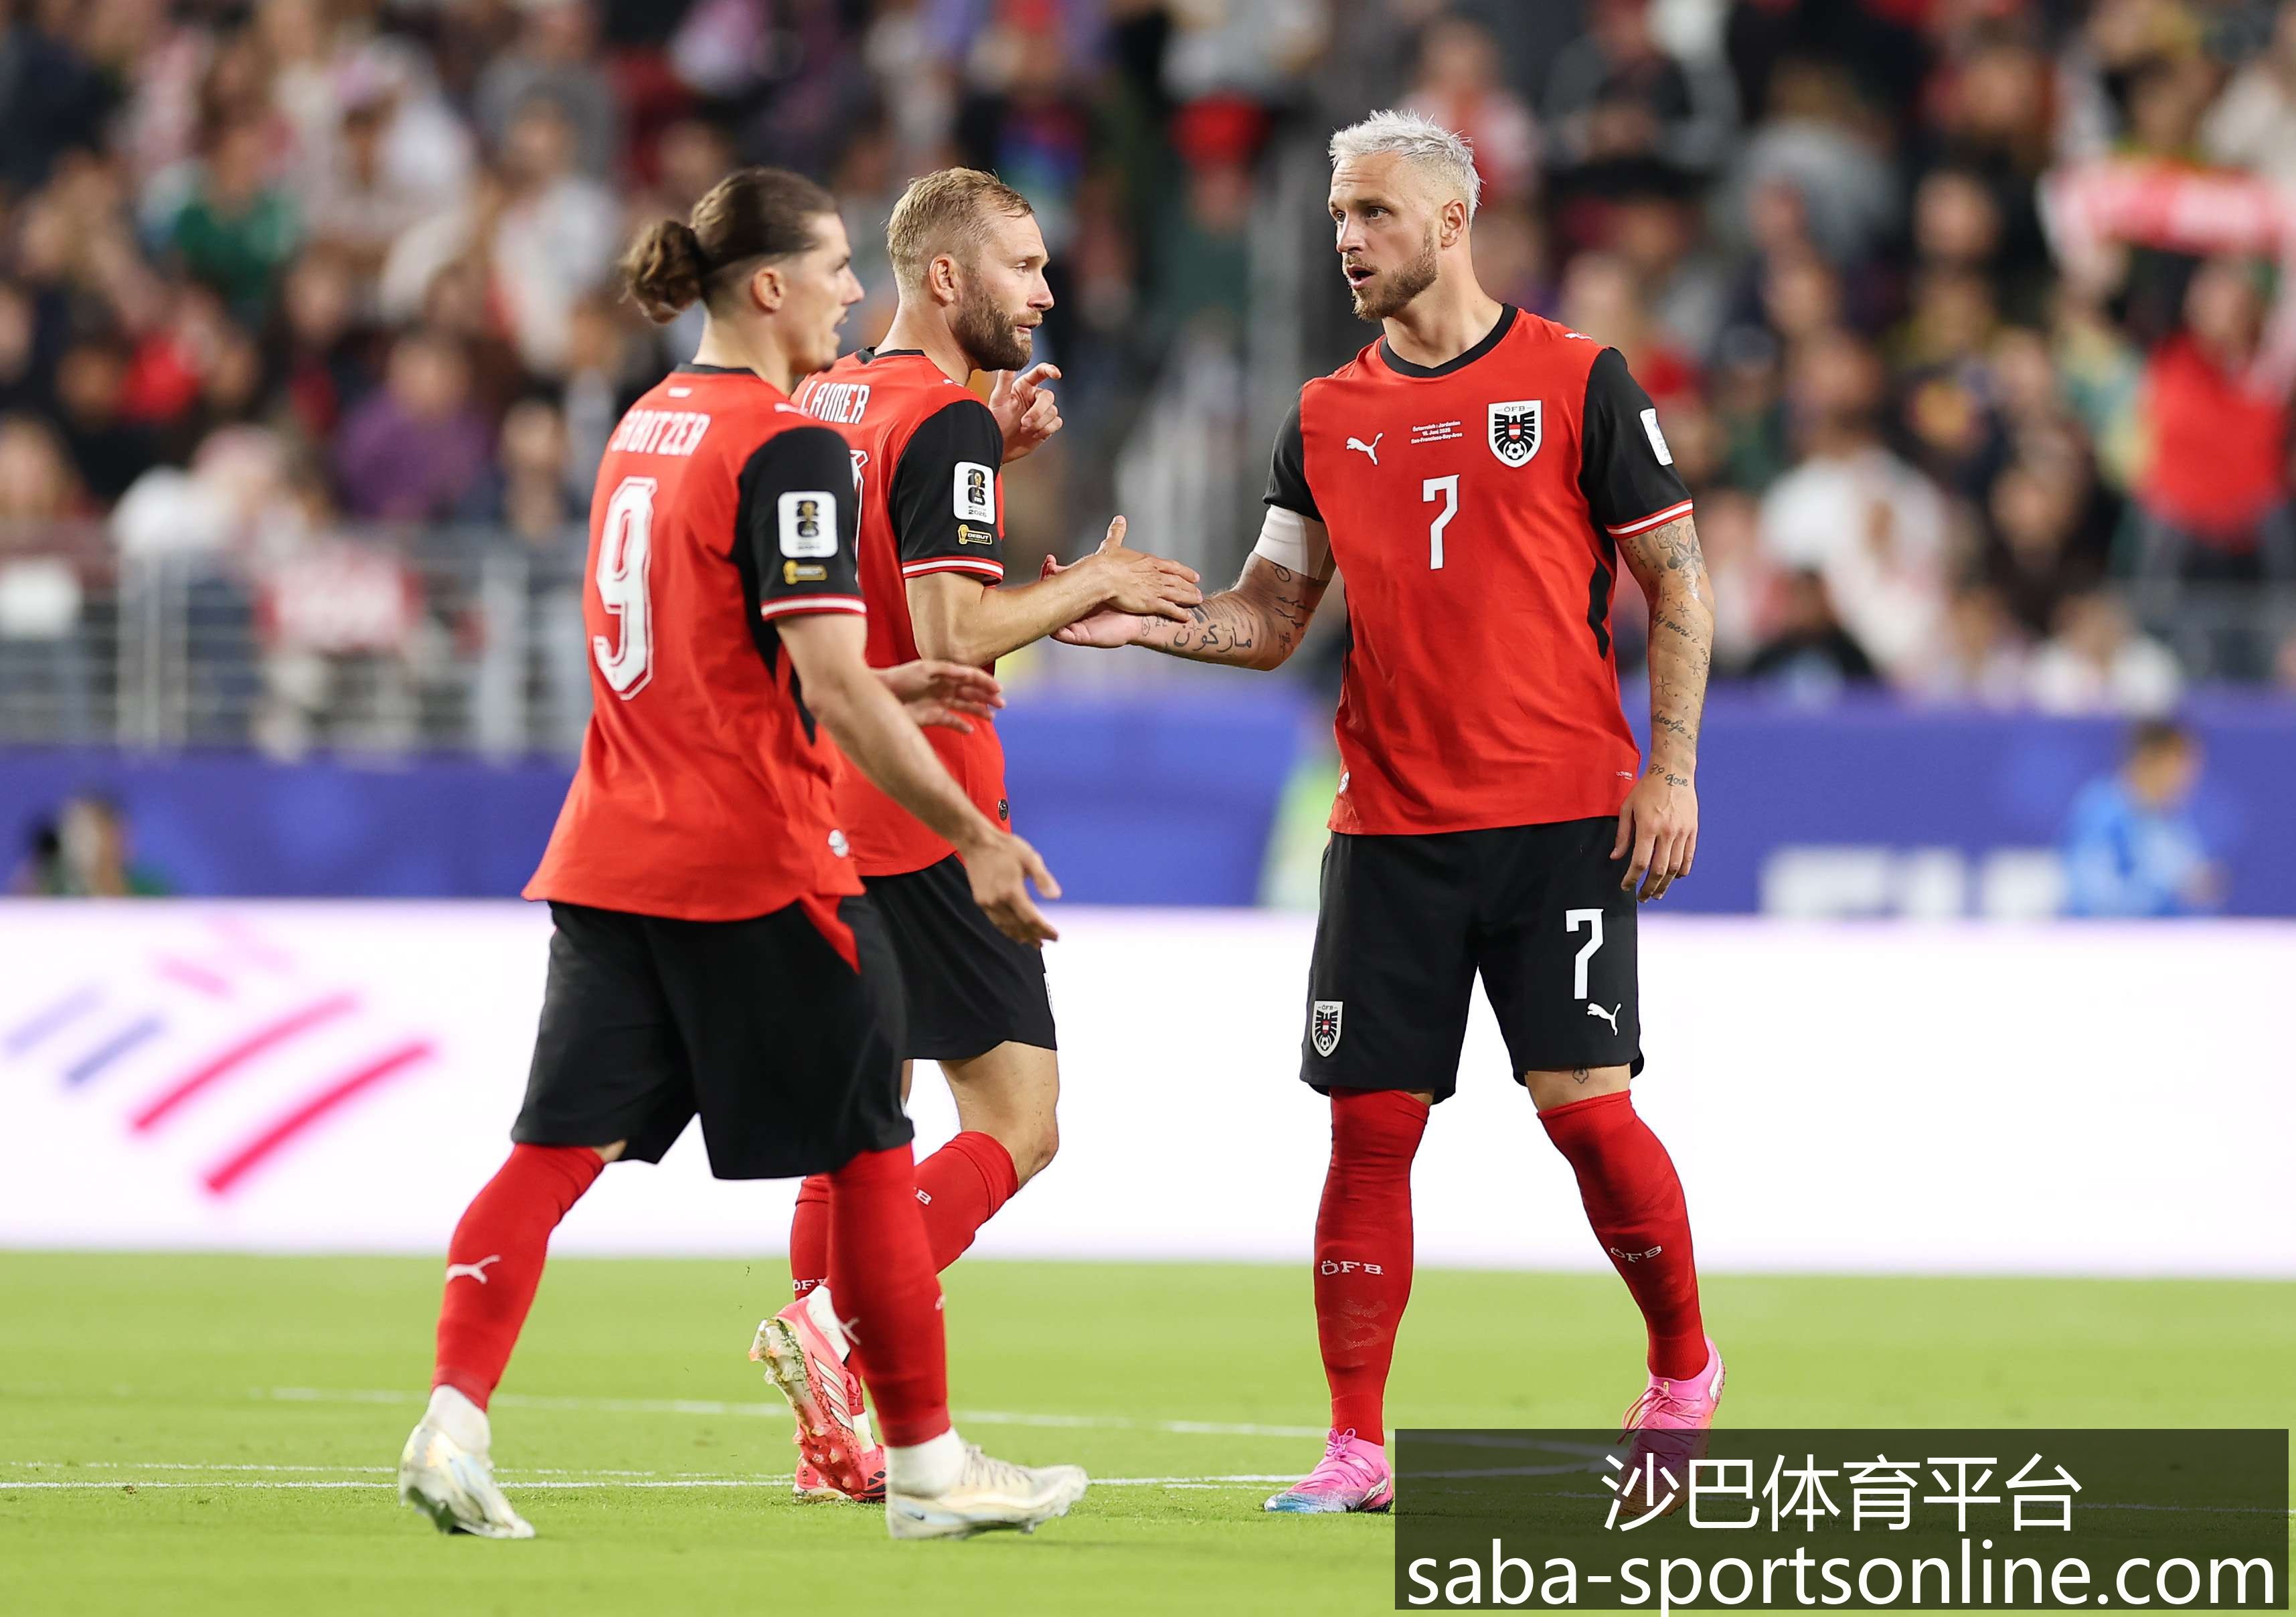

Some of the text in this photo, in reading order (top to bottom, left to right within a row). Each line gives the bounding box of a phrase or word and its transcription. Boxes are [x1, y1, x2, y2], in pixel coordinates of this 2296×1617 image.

[801, 379, 870, 424] LAIMER
[1422, 474, 1460, 570] 7
[592, 476, 657, 700] 9
[1566, 908, 1605, 1000] 7
